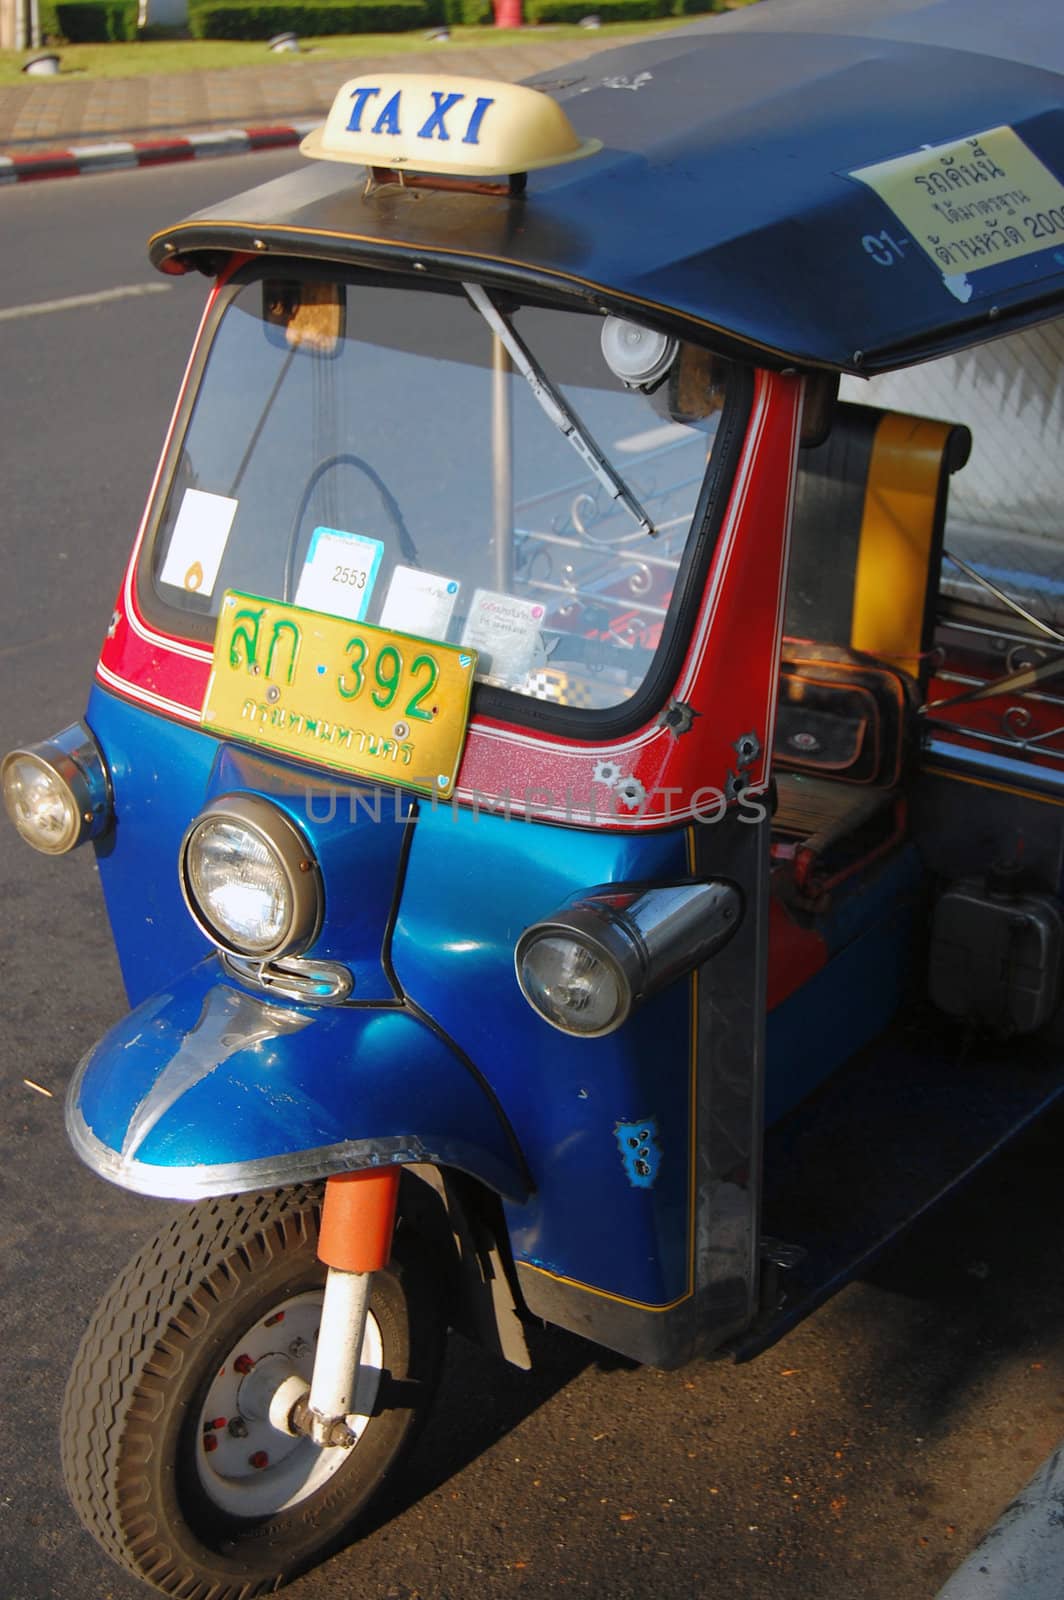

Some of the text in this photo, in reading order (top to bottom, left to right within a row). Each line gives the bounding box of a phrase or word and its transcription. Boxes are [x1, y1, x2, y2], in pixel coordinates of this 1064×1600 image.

[345, 87, 495, 144] TAXI
[914, 138, 1006, 196] รถคันนี้
[1023, 205, 1064, 238] 200
[332, 565, 367, 590] 2553
[229, 607, 441, 724] สก 392
[241, 698, 416, 766] กรุงเทพมหานคร
